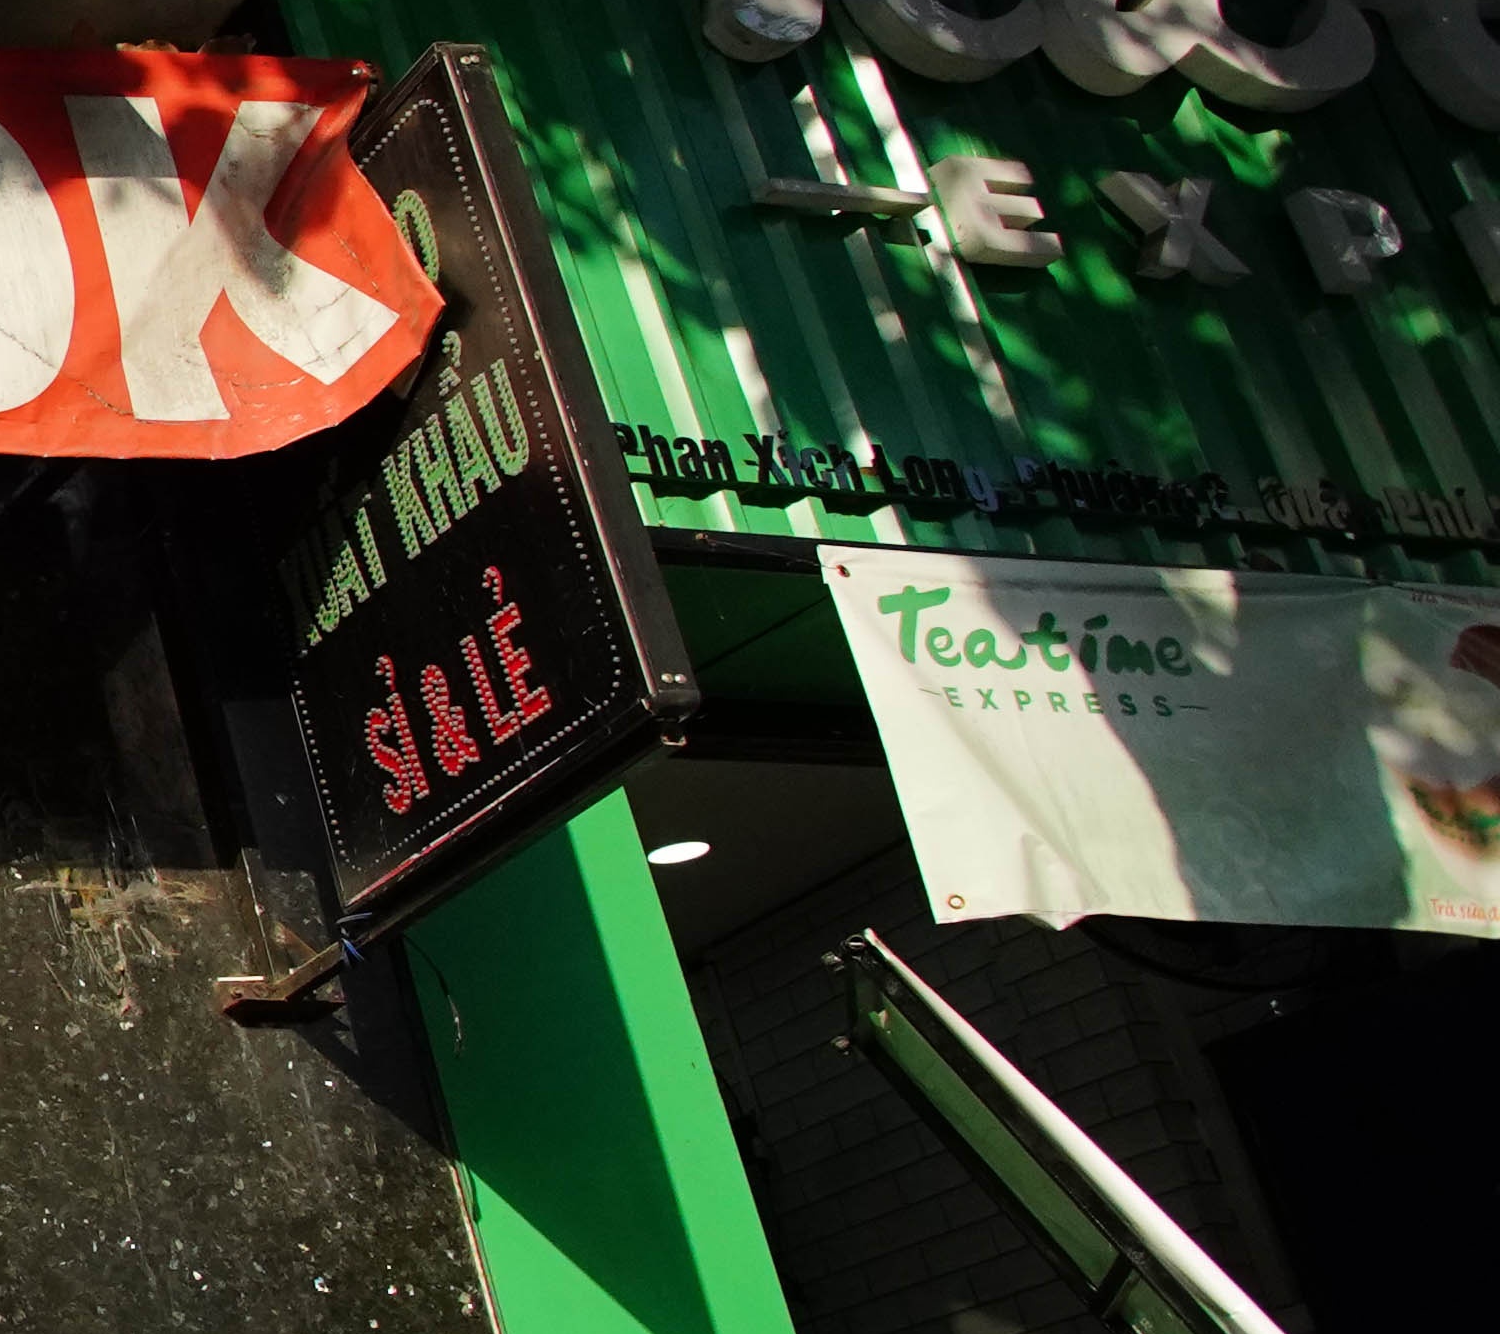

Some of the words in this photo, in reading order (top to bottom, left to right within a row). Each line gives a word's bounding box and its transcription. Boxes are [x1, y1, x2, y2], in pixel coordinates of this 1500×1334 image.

[380, 331, 530, 561] KHẨU
[364, 653, 430, 815] SỈ
[420, 664, 481, 776] &
[459, 565, 553, 746] LẺ
[944, 686, 1173, 718] EXPRESS
